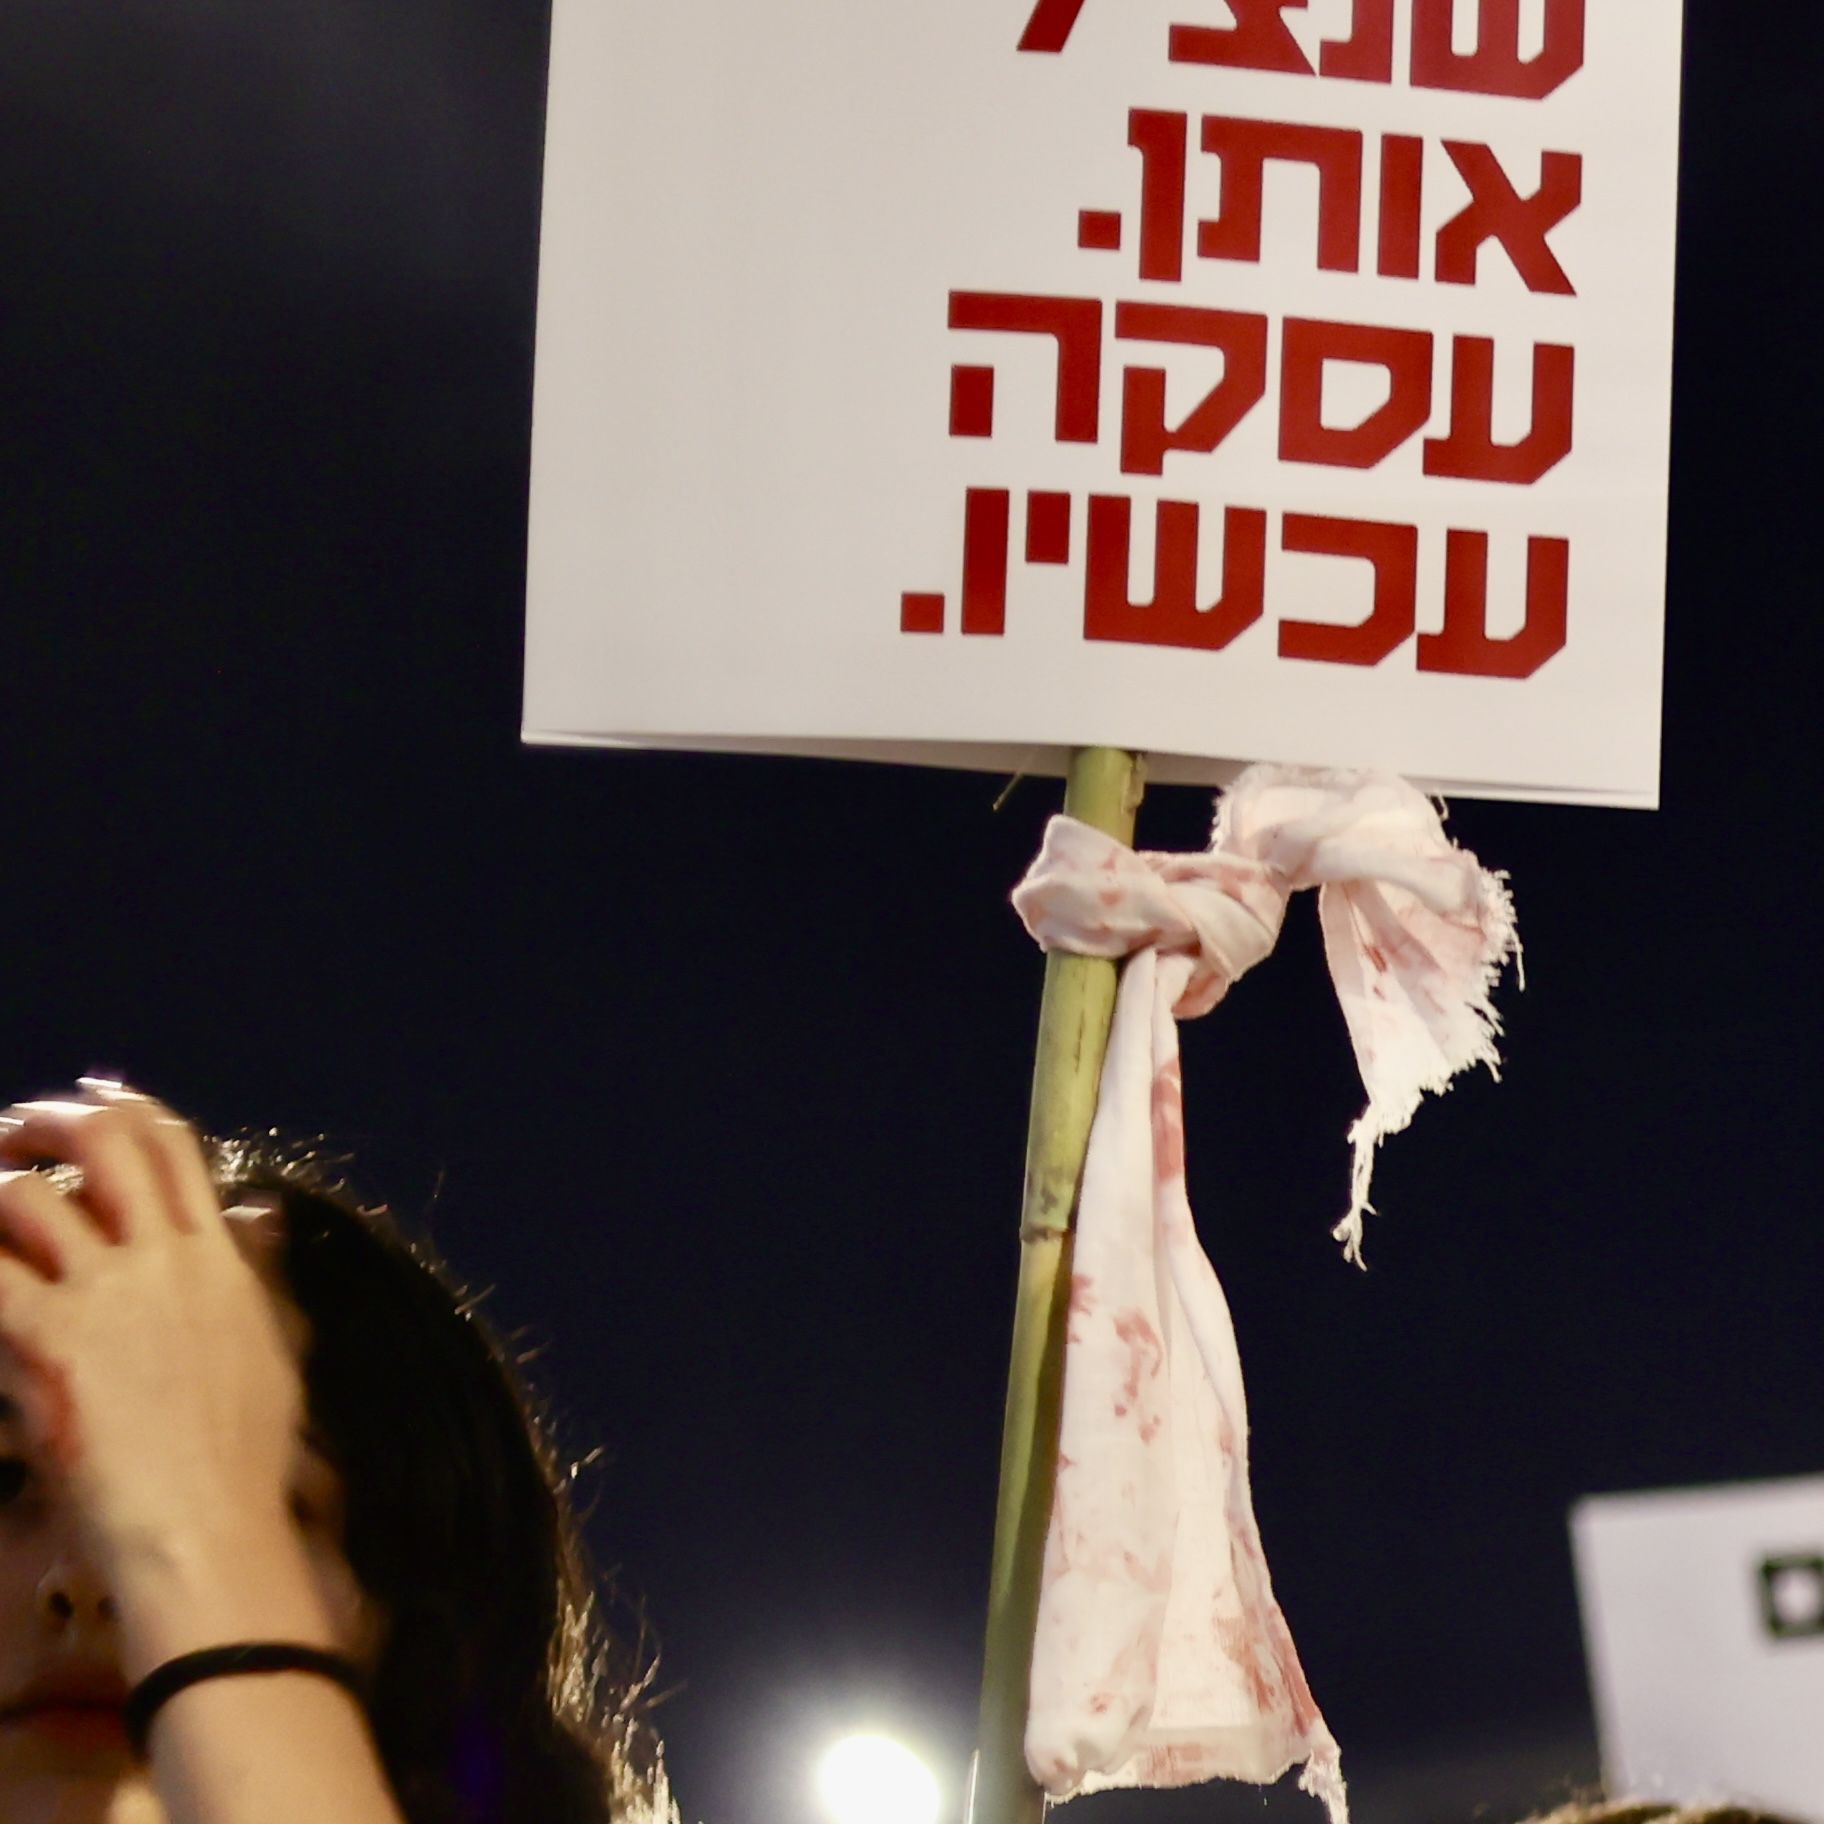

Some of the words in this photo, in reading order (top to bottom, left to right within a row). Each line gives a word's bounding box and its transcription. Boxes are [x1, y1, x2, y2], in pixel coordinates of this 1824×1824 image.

[1016, 0, 1585, 101] שנצ
[1078, 106, 1583, 297] אותן.
[948, 289, 1575, 486] עסקה
[900, 486, 1569, 680] עכשיו.
